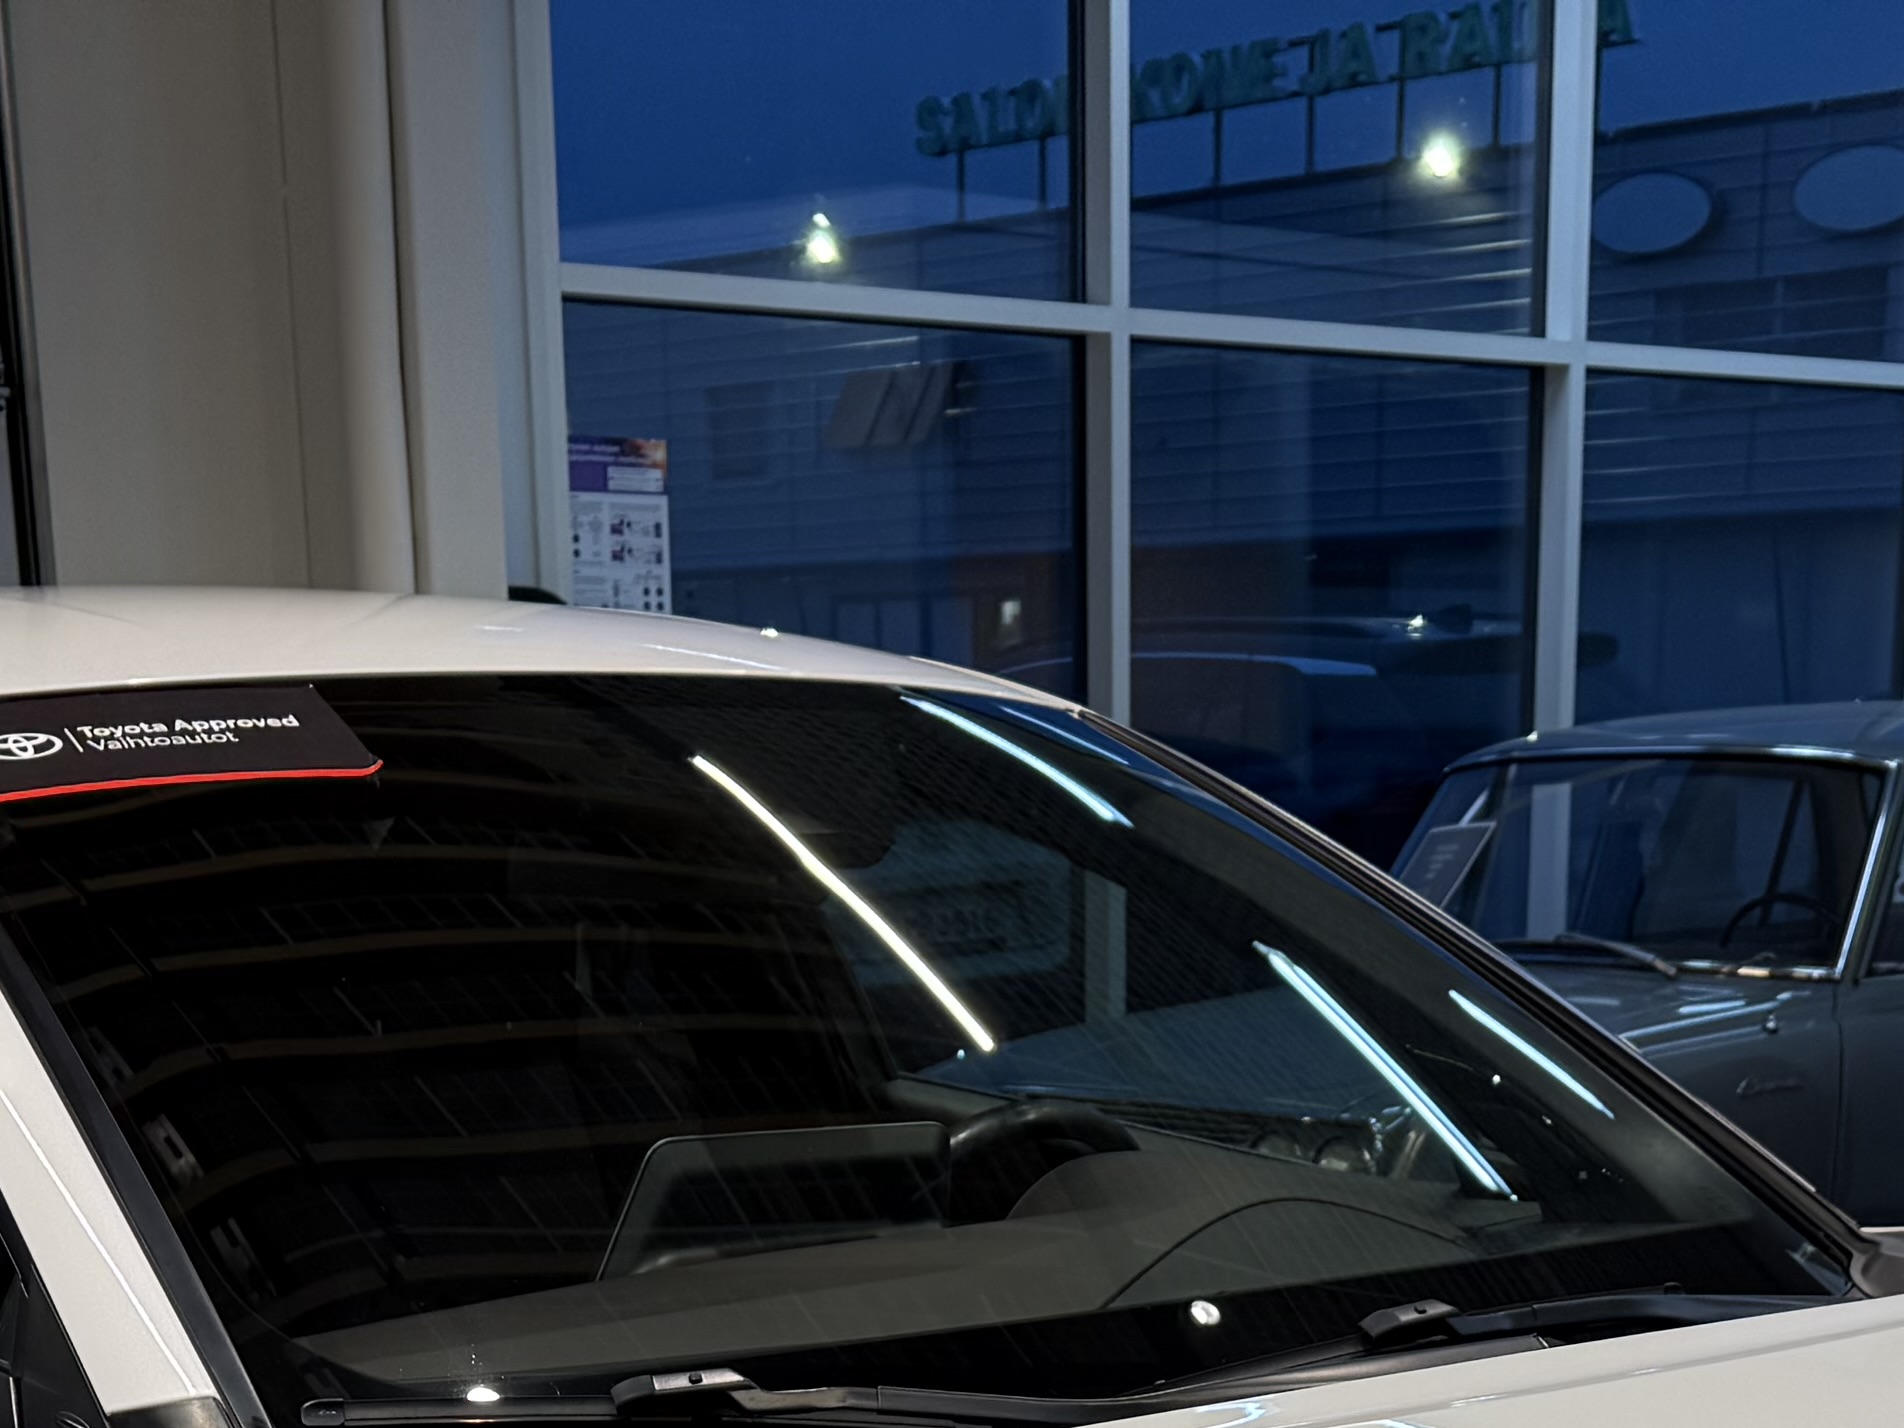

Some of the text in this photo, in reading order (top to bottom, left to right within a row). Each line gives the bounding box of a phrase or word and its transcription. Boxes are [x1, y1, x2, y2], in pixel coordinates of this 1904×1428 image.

[76, 714, 300, 740] Toyota Approved
[86, 733, 240, 752] Vaihtoautot
